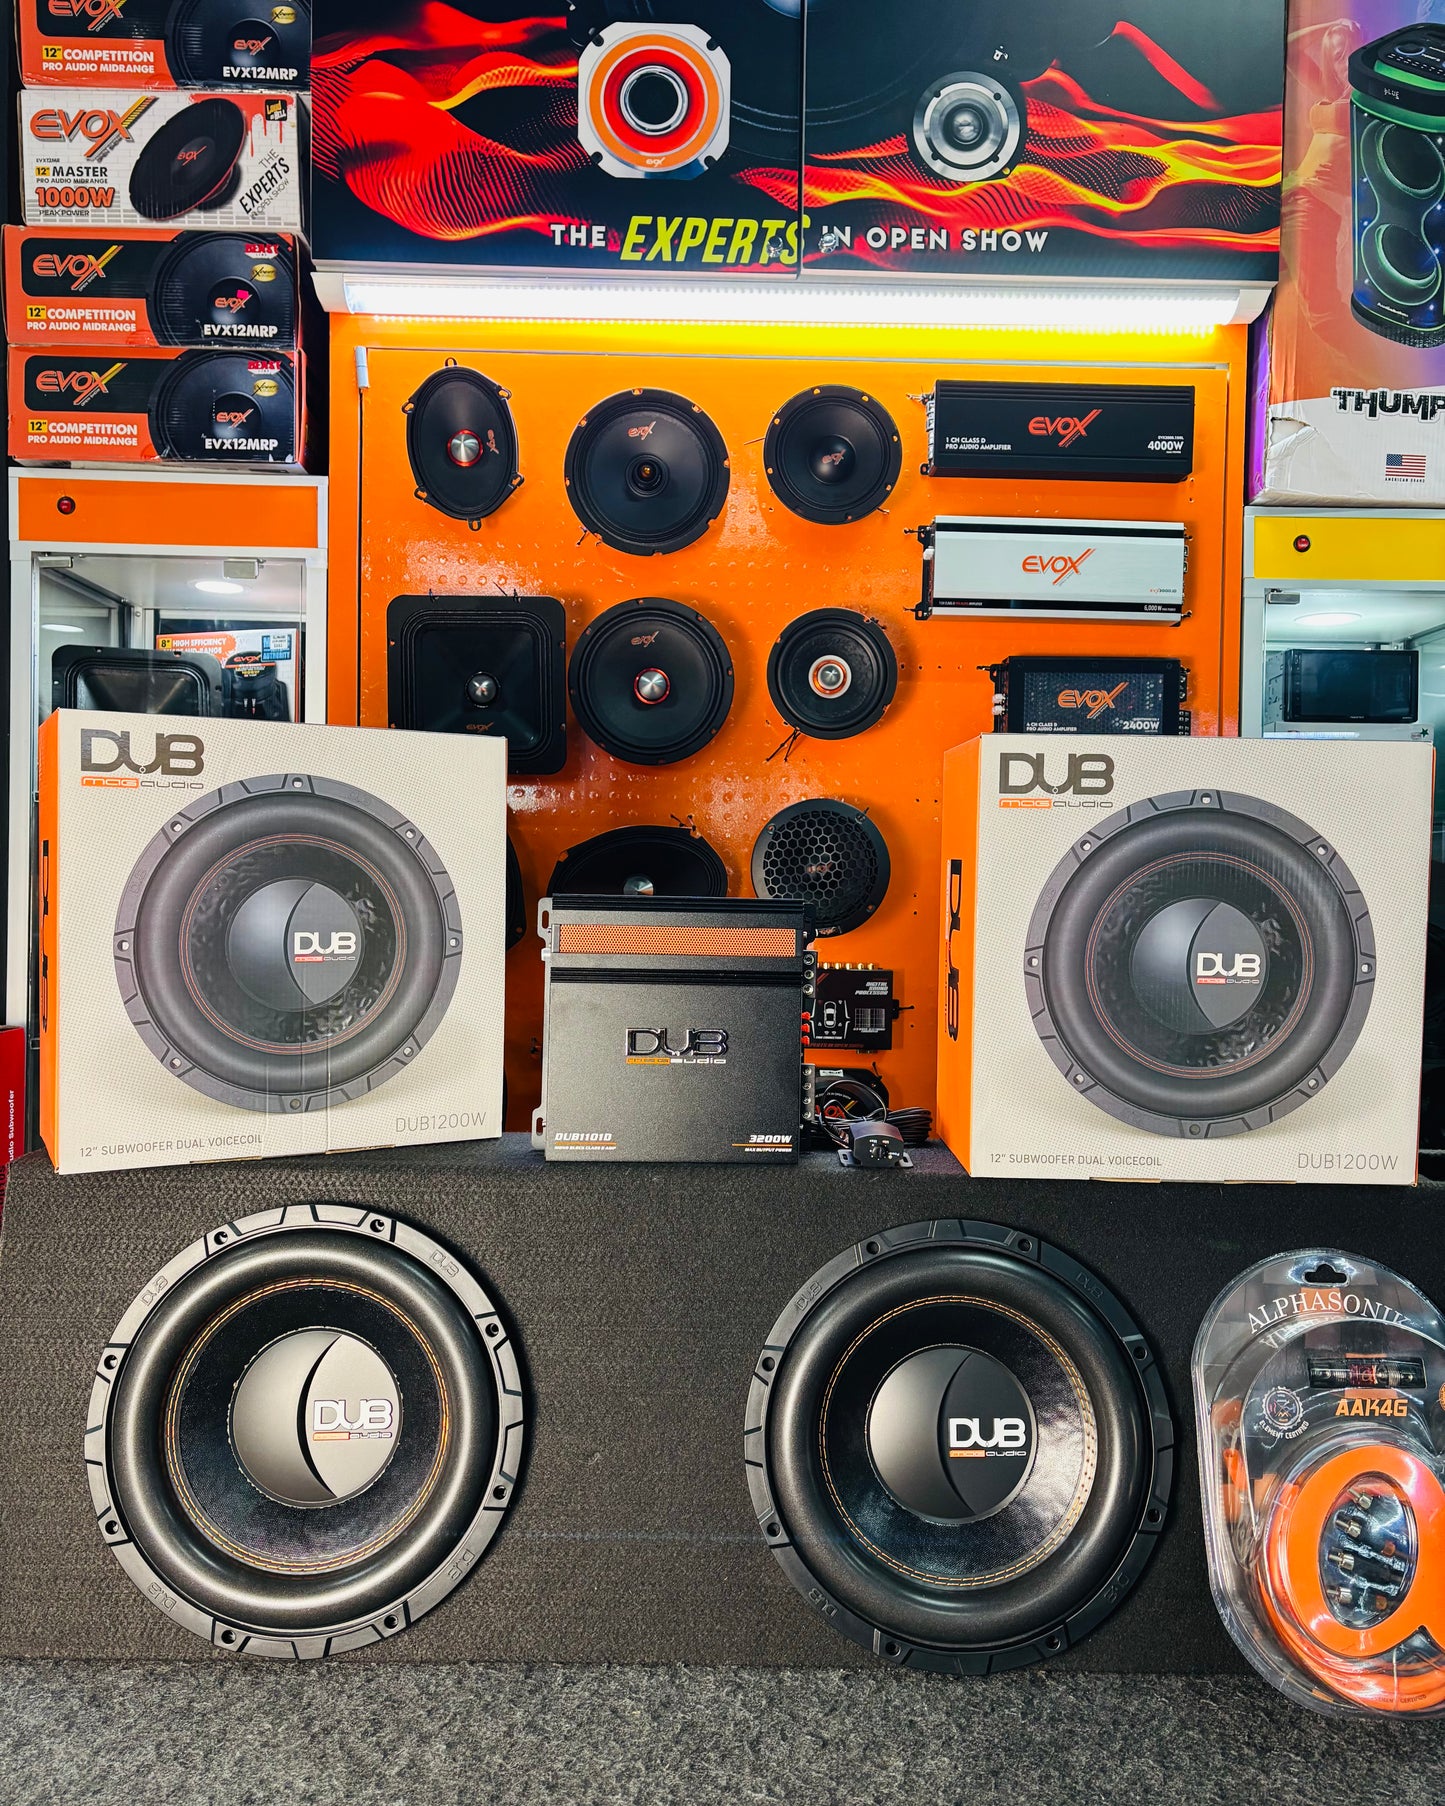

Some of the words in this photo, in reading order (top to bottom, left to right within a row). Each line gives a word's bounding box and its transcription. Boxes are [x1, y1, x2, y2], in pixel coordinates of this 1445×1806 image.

[43, 47, 62, 59] 12"
[63, 48, 154, 63] COMPETITION
[42, 62, 62, 71] PRO
[64, 63, 98, 72] AUDIO
[100, 64, 155, 74] MIDRANGE
[222, 66, 298, 80] EVX12MRP
[29, 95, 159, 159] EVOX
[258, 148, 280, 169] THE
[52, 166, 108, 177] MASTER
[239, 156, 290, 215] EXPERTS
[256, 194, 274, 215] OPEN
[271, 177, 290, 197] SHOW
[35, 186, 116, 208] 1000W
[61, 209, 90, 217] POWER
[551, 223, 607, 248] THE
[620, 214, 813, 264] EXPERTS
[865, 226, 948, 250] OPEN
[961, 229, 1049, 253] SHOW
[32, 245, 123, 291] EVOX
[28, 307, 45, 318] 12"
[47, 308, 136, 321] COMPETITION
[26, 321, 47, 331] PRO
[48, 322, 81, 331] AUDIO
[82, 322, 137, 332] MIDRANGE
[203, 324, 278, 338] EVX12MRP
[36, 363, 128, 406] EVOX
[29, 421, 47, 432] 12"
[48, 422, 138, 435] COMPETITION
[1028, 409, 1103, 448] EVOX
[27, 436, 47, 444] PRO
[49, 436, 82, 445] AUDIO
[83, 437, 138, 446] MIDRANGE
[204, 438, 279, 451] EVX12MRP
[1147, 441, 1184, 451] 4000W
[1021, 548, 1097, 587] EVOX
[161, 640, 171, 648] 8"
[190, 638, 227, 647] EFFICIENCY
[1057, 681, 1130, 719] EVOX
[1123, 721, 1160, 730] 2400W
[80, 728, 205, 776] DUB
[999, 753, 1115, 795] DUB
[140, 780, 204, 790] audio
[1052, 799, 1114, 809] audio
[294, 931, 356, 954] DUB
[1196, 953, 1260, 977] DUB
[625, 1027, 729, 1057] DUB
[395, 1111, 487, 1133] DUB1200W
[79, 1146, 98, 1157] 12"
[101, 1140, 173, 1155] SUBWOOFER
[176, 1137, 205, 1149] DUAL
[208, 1134, 263, 1147] VOICECOIL
[555, 1132, 613, 1142] DUB1101D
[749, 1134, 792, 1144] 3200W
[990, 1154, 1006, 1163] 12"
[1008, 1154, 1075, 1165] SUBWOOFER
[1077, 1155, 1105, 1166] DUAL
[1108, 1156, 1162, 1167] VOICECOIL
[1297, 1153, 1399, 1171] DUB1200W
[429, 1249, 460, 1278] DUB
[140, 1276, 169, 1307] DUB
[1248, 1291, 1412, 1335] ALPHASONIK
[313, 1399, 394, 1431] DUB
[1335, 1399, 1409, 1417] AAK4G
[949, 1417, 1026, 1449] DUB
[1258, 1420, 1284, 1439] ELEMENT
[1284, 1421, 1310, 1440] CERTIFIED
[986, 1449, 1027, 1458] audio
[149, 1581, 177, 1612] DUB
